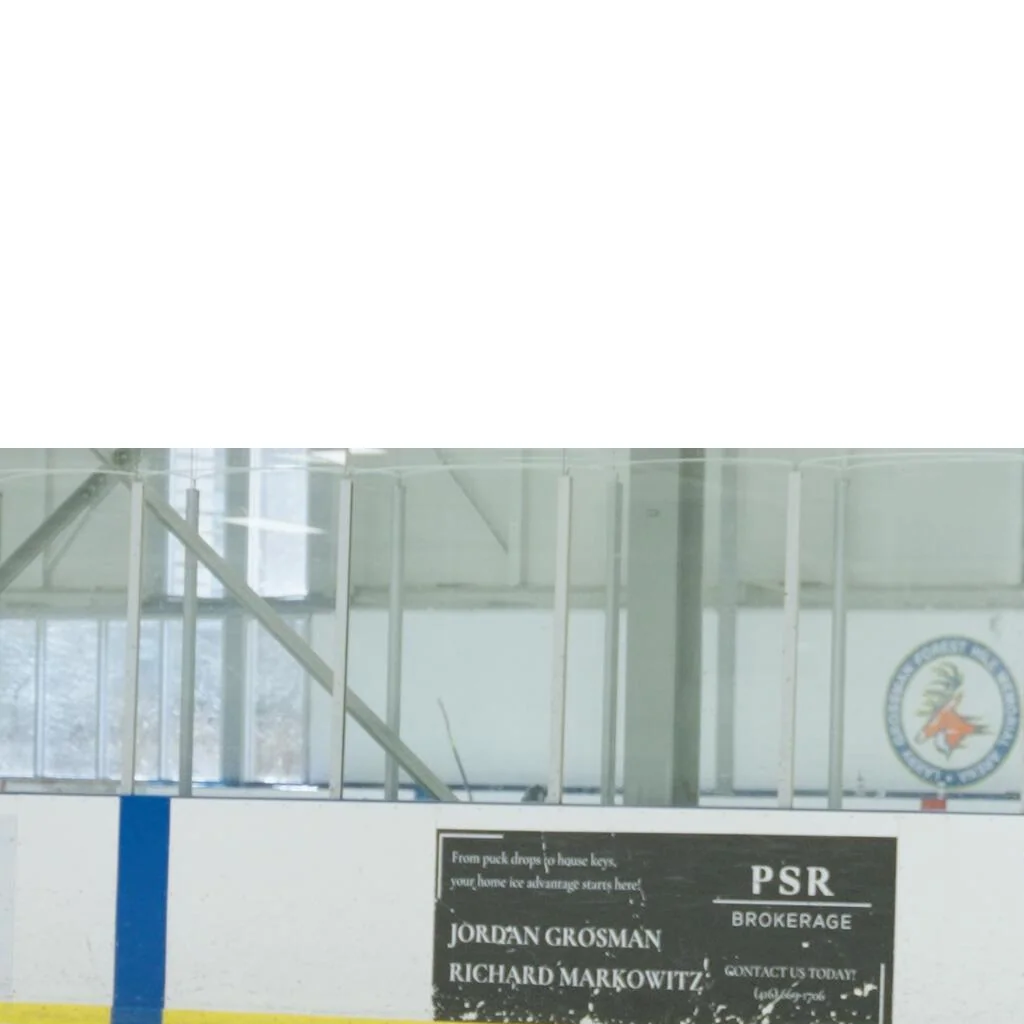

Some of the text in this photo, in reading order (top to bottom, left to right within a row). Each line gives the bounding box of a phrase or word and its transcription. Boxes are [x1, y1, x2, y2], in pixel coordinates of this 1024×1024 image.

[913, 639, 967, 666] FOREST
[451, 851, 480, 865] From
[482, 852, 509, 868] puck
[511, 852, 541, 869] drops
[557, 853, 589, 867] house
[591, 852, 617, 871] keys,
[450, 873, 641, 893] your home ice advantage starts here!
[751, 865, 835, 897] PSR
[732, 911, 853, 930] BROKERAGE
[447, 922, 662, 951] JORDAN GROSMAN
[450, 962, 704, 991] RICHARD MARKOWITZ
[724, 964, 857, 981] CONTACT US TODAY!
